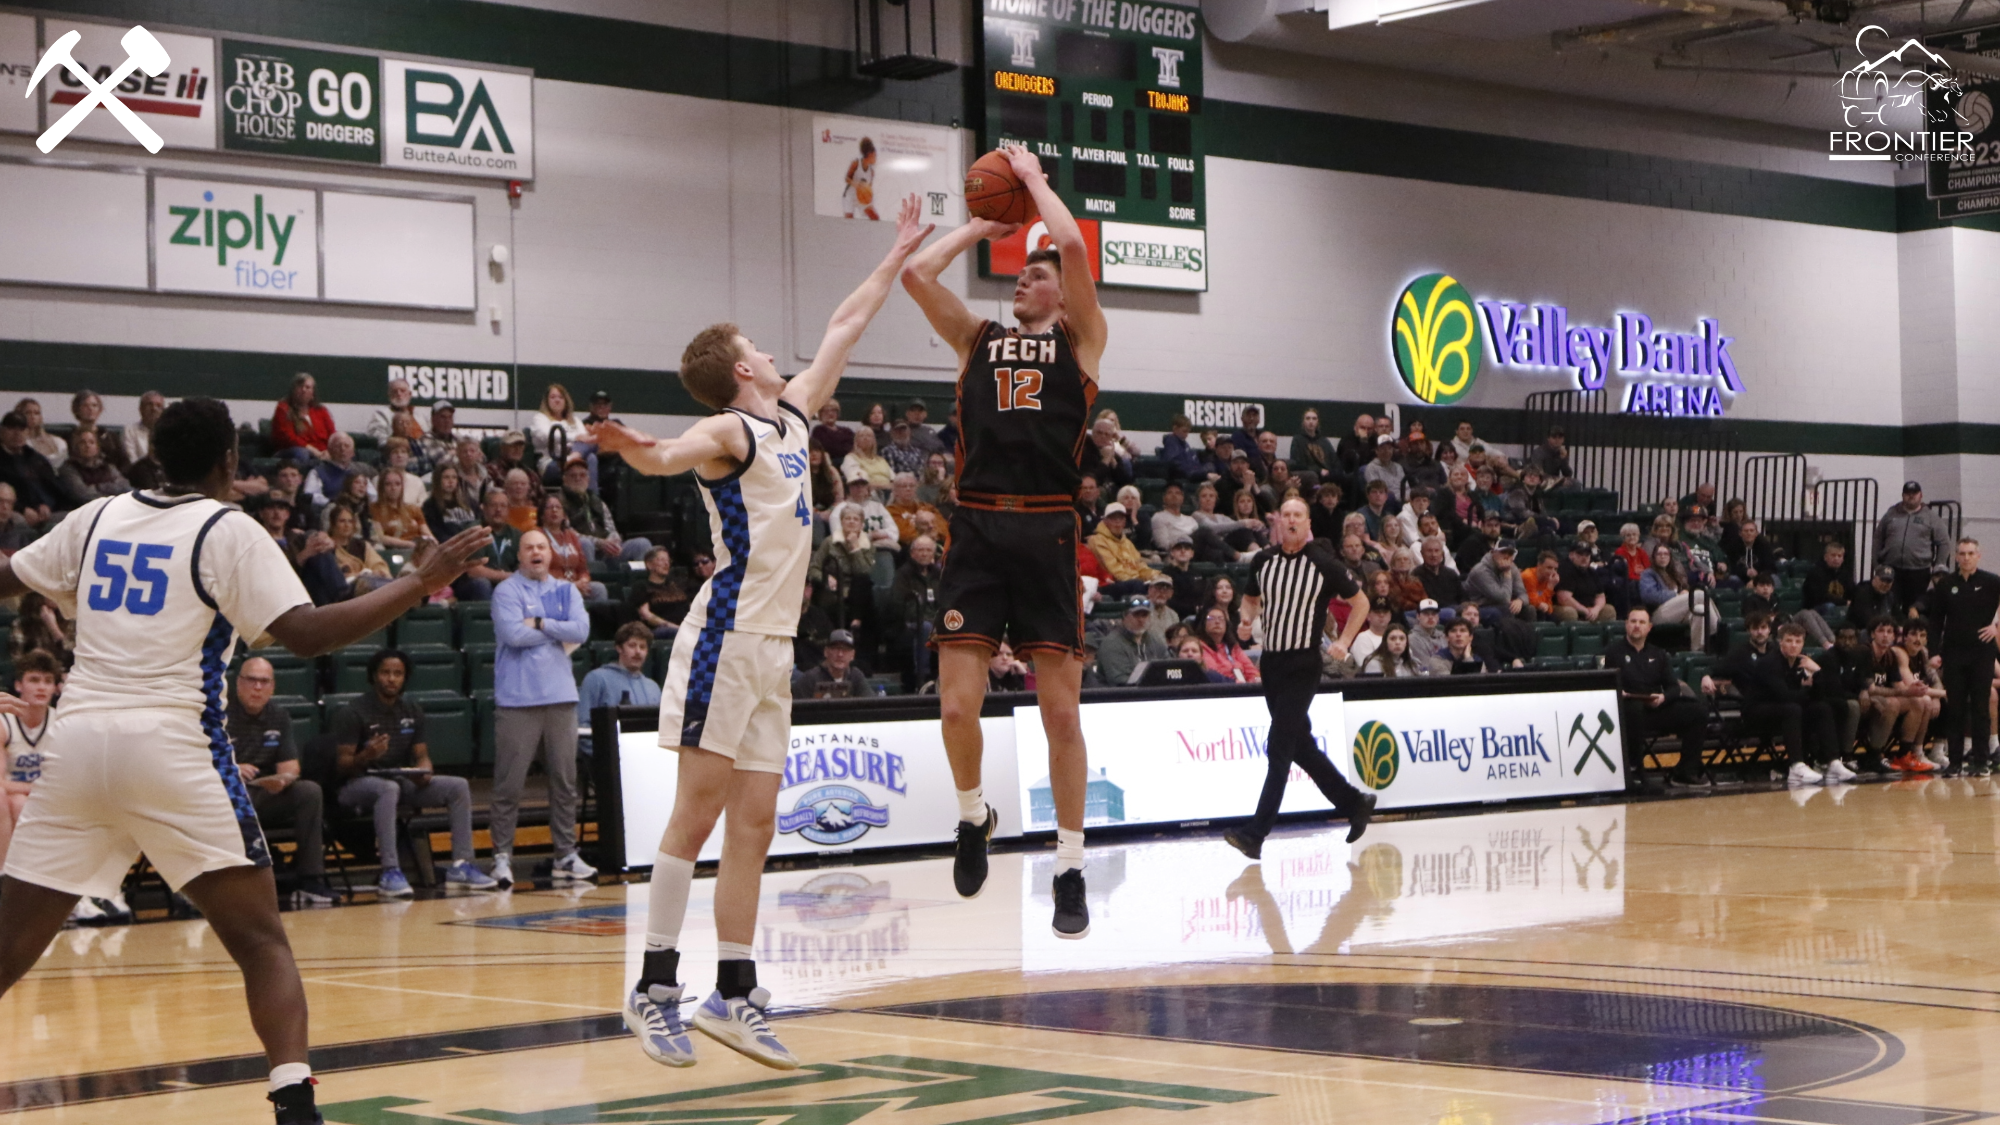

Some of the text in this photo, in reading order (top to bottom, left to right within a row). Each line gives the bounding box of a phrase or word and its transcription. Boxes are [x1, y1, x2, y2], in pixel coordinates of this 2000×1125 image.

[1081, 0, 1115, 28] THE
[1119, 2, 1196, 40] DIGGERS
[307, 68, 372, 121] GO
[994, 70, 1055, 96] OREDIGGERS
[224, 85, 303, 118] CHOP
[1082, 91, 1114, 108] PERIOD
[1147, 90, 1190, 113] TROJANS
[235, 113, 297, 140] HOUSE
[306, 121, 375, 146] DIGGERS
[403, 147, 518, 170] ButteAuto.com
[1072, 146, 1104, 162] PLAYER
[1106, 150, 1128, 165] FOUL
[1167, 157, 1195, 172] FOULS
[1085, 198, 1116, 213] MATCH
[1169, 206, 1196, 221] SCORE
[169, 190, 296, 266] ziply
[1104, 240, 1203, 273] STEELE'S
[235, 260, 298, 290] fiber
[987, 337, 1056, 363] TECH
[1478, 301, 1746, 394] Valley Bank
[994, 367, 1043, 411] 12
[1624, 383, 1725, 417] ARENA
[1184, 399, 1265, 429] RESERVD
[795, 482, 811, 527] 4
[87, 539, 174, 616] 55
[791, 734, 879, 750] ONTANA'S
[1400, 724, 1552, 772] Valley Bank
[780, 747, 908, 798] REASURE
[1486, 762, 1541, 781] ARENA
